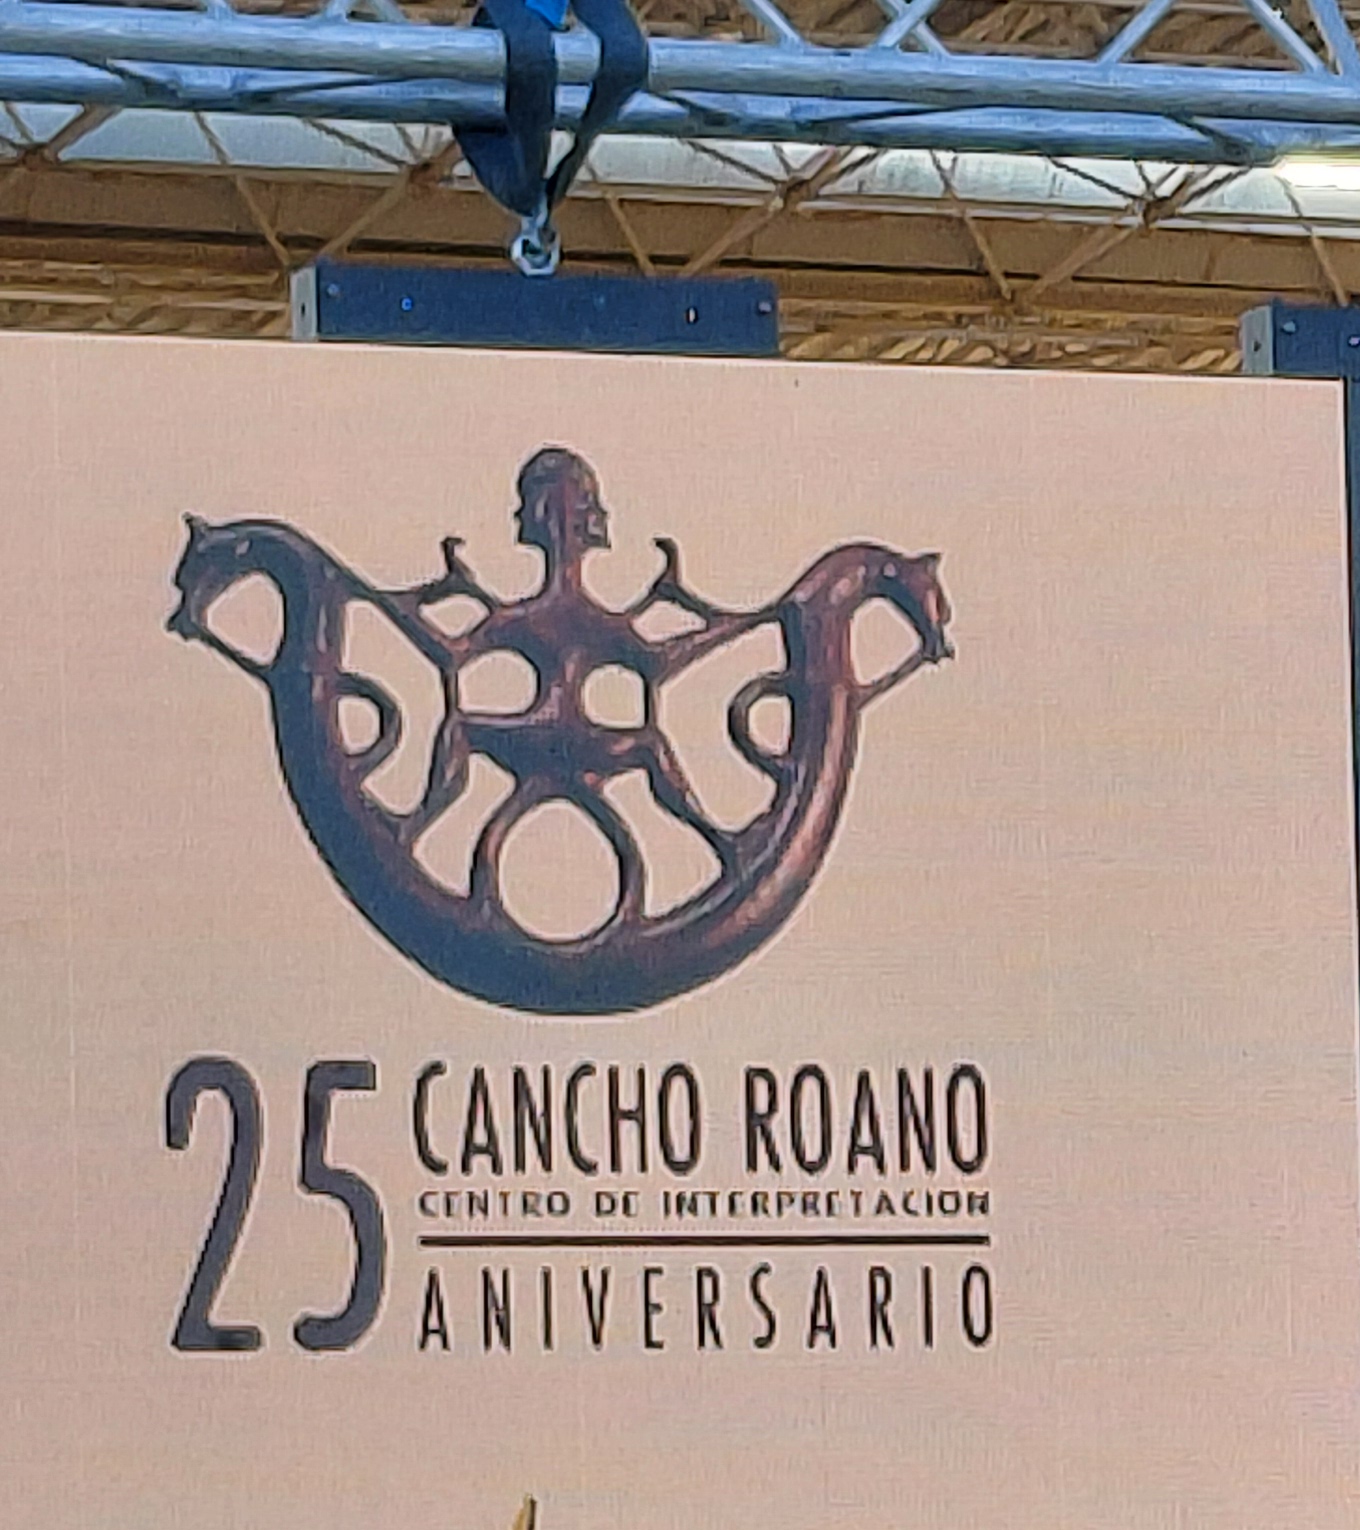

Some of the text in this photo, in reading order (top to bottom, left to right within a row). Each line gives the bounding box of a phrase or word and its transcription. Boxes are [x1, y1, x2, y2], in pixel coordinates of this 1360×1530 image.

[413, 1060, 988, 1177] CANCHO ROANO
[165, 1055, 388, 1353] 25
[418, 1189, 990, 1219] CENTRO DE INTERPRETACION
[418, 1261, 993, 1353] ANIVERSARIO
